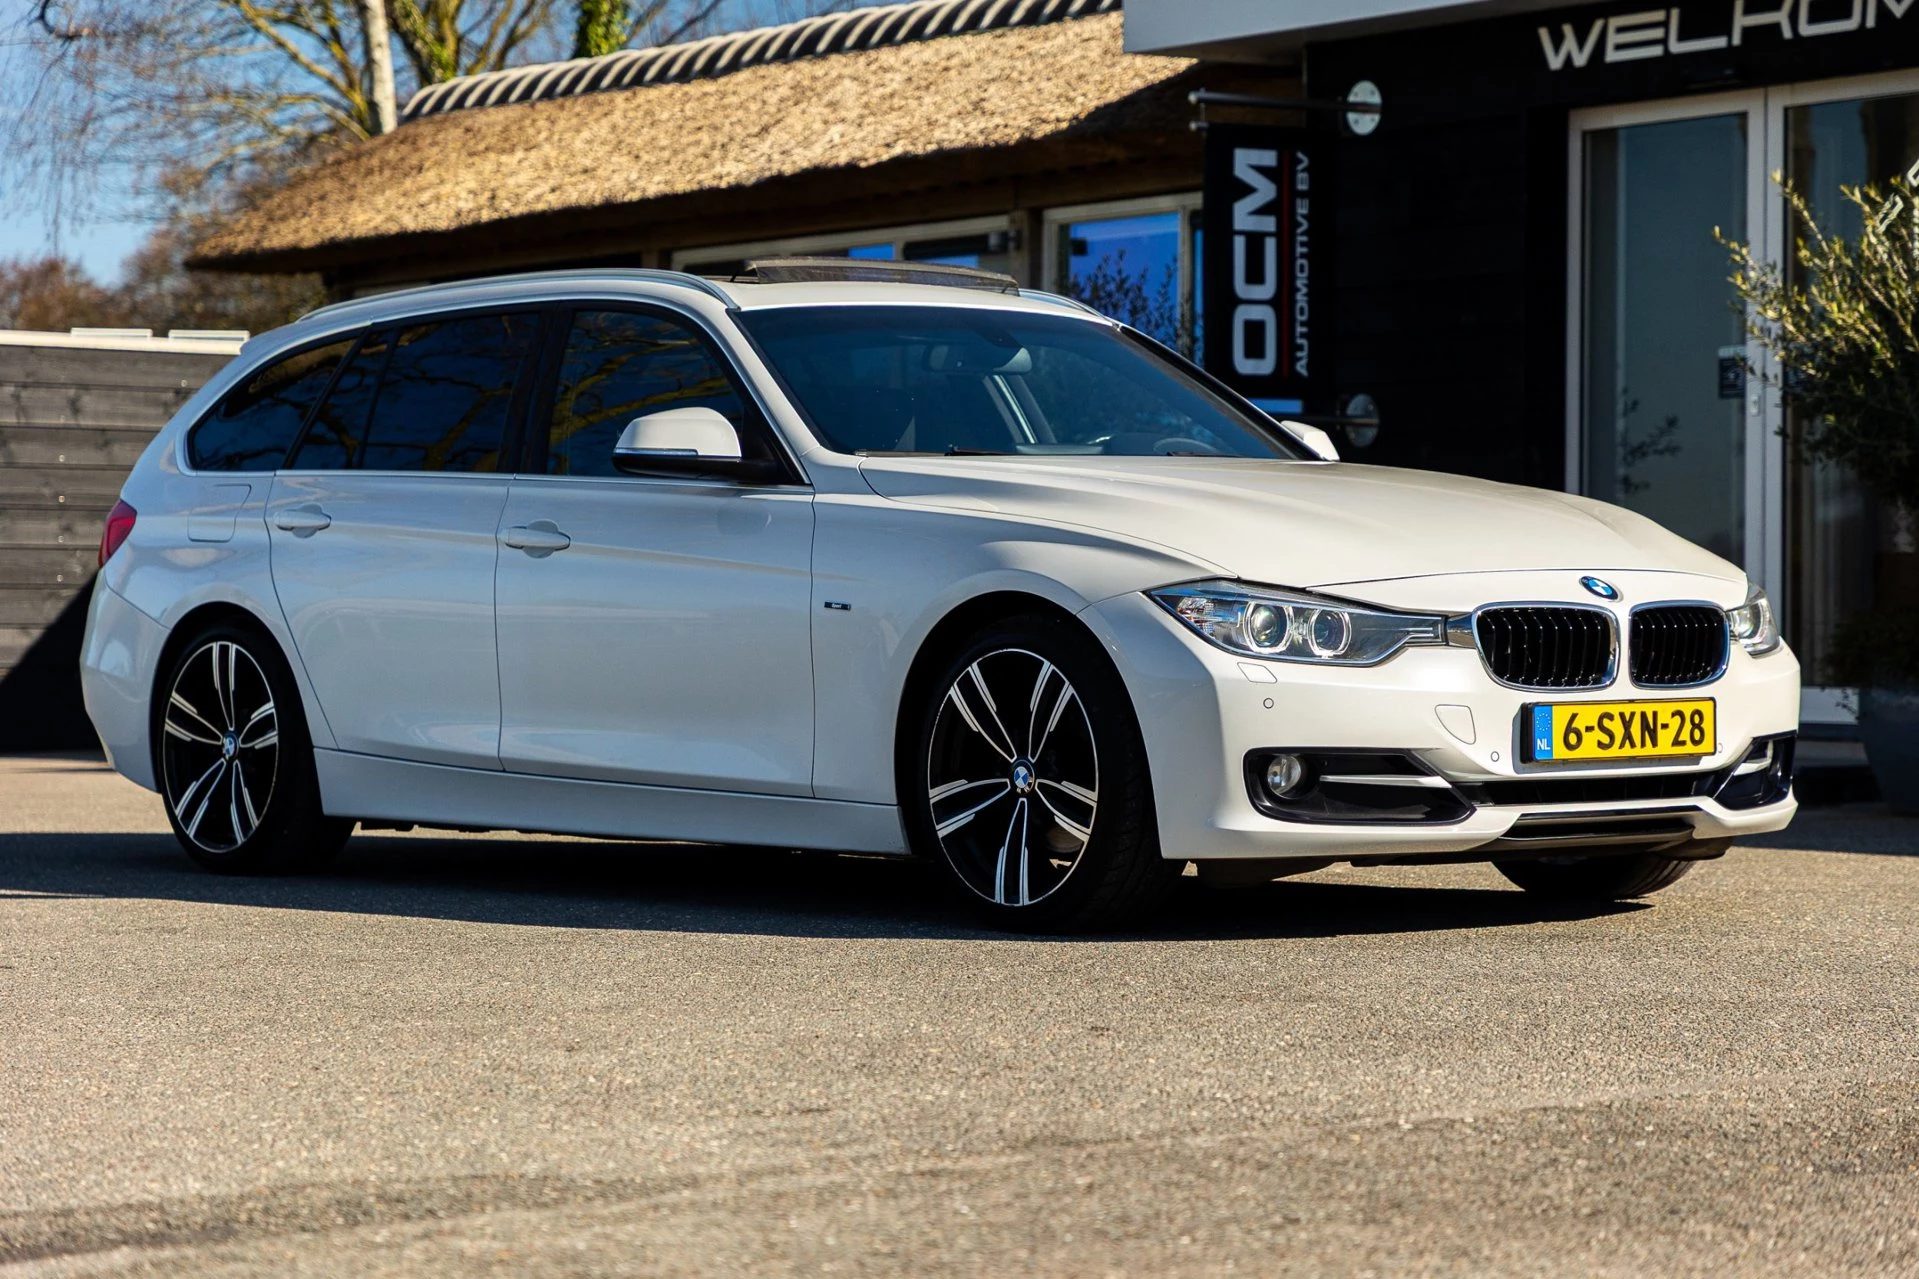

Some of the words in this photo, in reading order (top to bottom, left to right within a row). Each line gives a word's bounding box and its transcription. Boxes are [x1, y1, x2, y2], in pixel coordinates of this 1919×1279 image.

[1296, 151, 1309, 190] BV
[1232, 148, 1277, 376] OCM
[1295, 197, 1309, 377] AUTOMOTIVE
[1537, 738, 1551, 751] NL
[1562, 708, 1706, 752] 6-SXN-28
